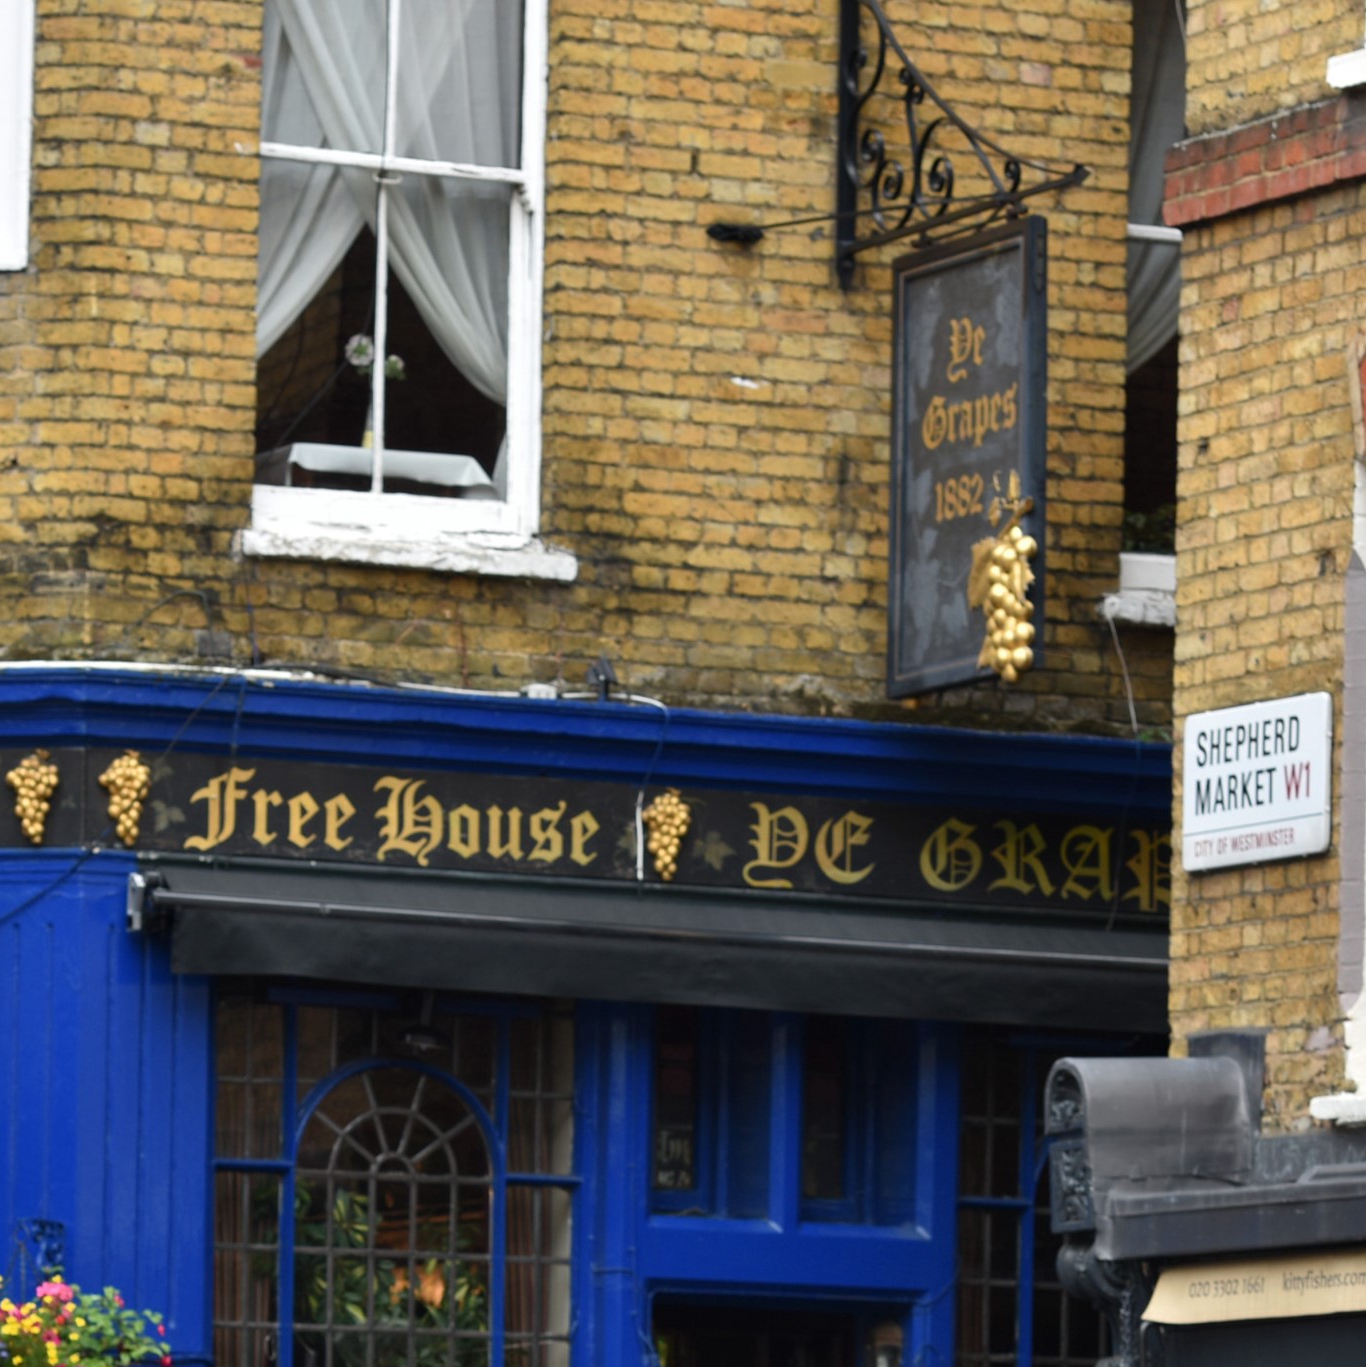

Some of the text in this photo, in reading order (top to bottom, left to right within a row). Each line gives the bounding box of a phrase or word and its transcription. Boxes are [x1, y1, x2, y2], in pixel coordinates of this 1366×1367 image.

[947, 317, 985, 383] Ye
[923, 382, 1017, 449] Grapes
[935, 473, 983, 523] 1882
[1196, 716, 1300, 767] SHEPHERD
[184, 767, 601, 867] Free House
[1194, 761, 1311, 816] MARKET W1
[742, 801, 875, 889] YE
[1194, 827, 1295, 858] CITY OF WESTMINSTER
